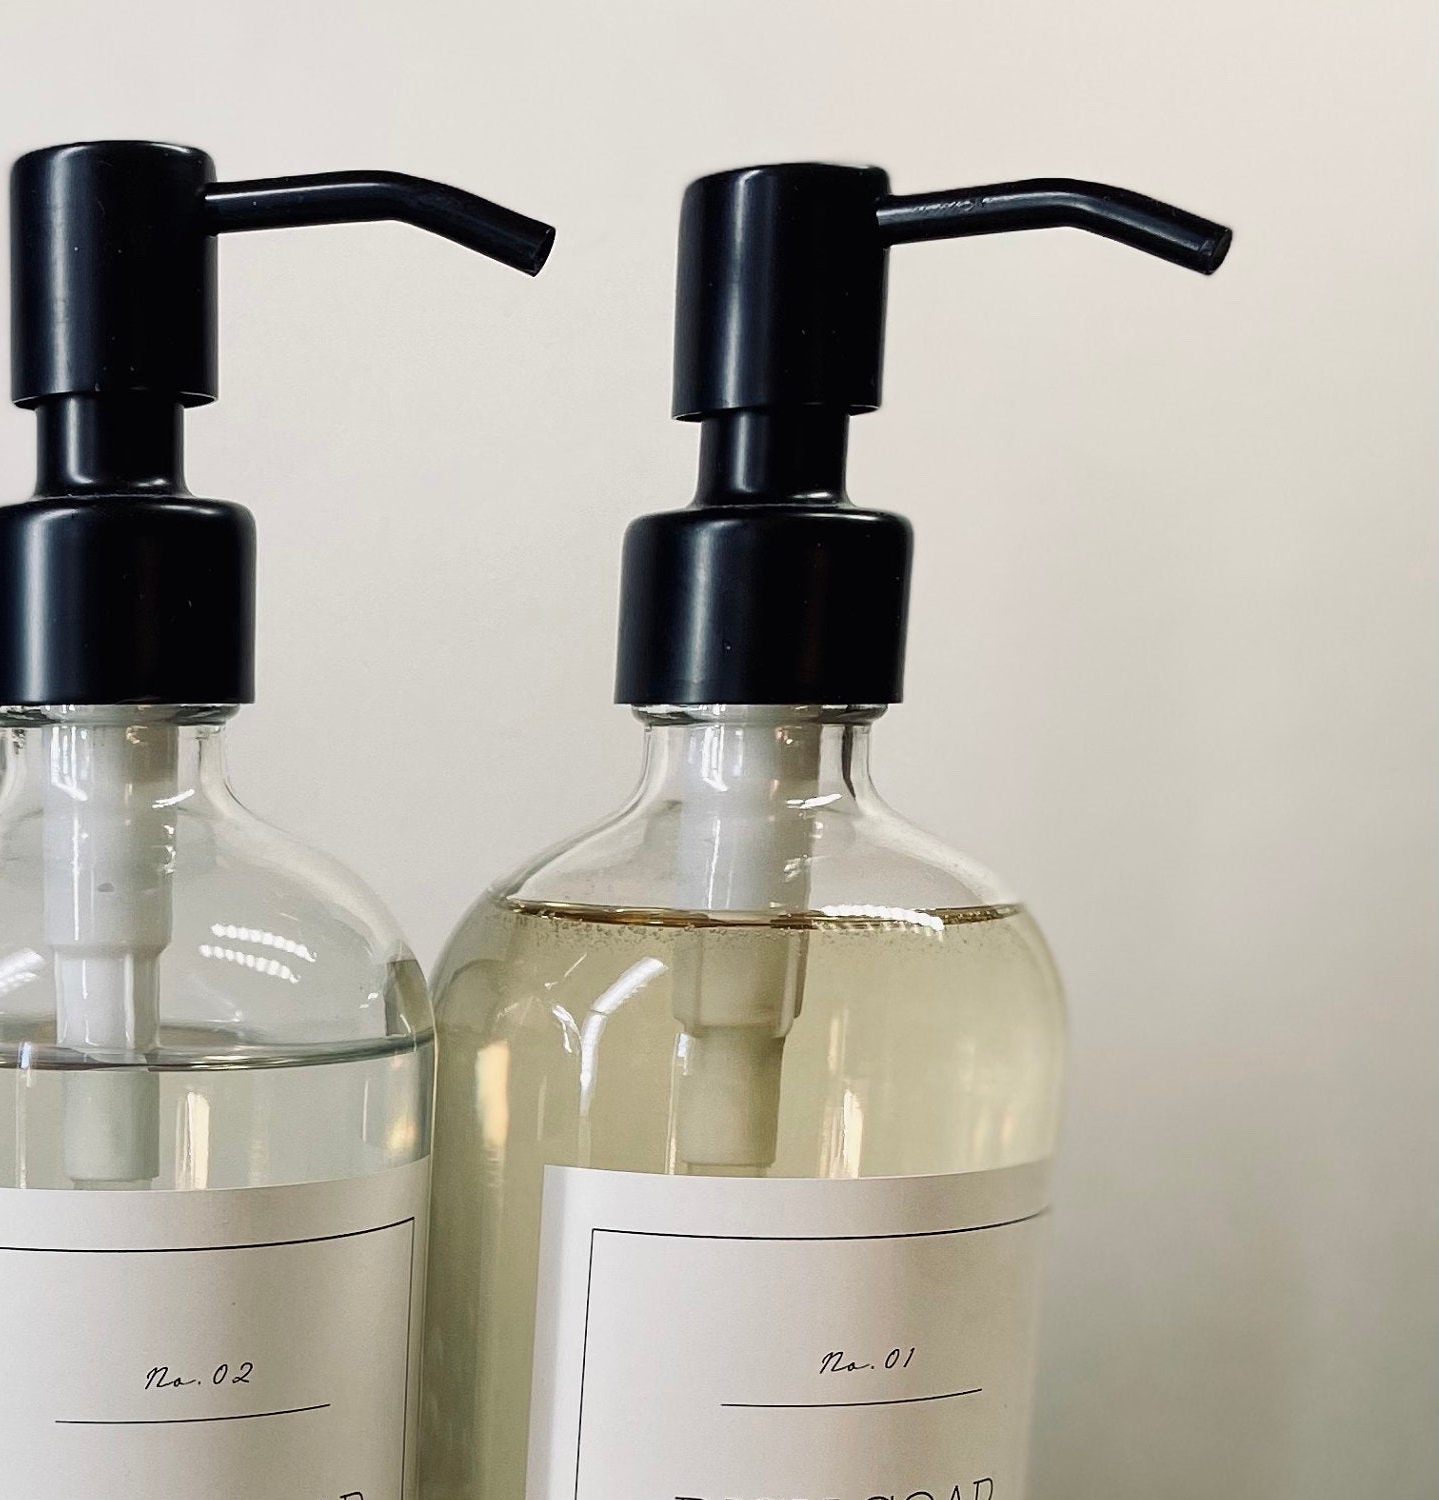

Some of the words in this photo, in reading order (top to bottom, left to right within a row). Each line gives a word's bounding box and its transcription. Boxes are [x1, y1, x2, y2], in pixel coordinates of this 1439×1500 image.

[818, 1351, 875, 1375] No.
[884, 1347, 916, 1370] 01
[144, 1366, 202, 1391] No.
[212, 1361, 254, 1385] 02
